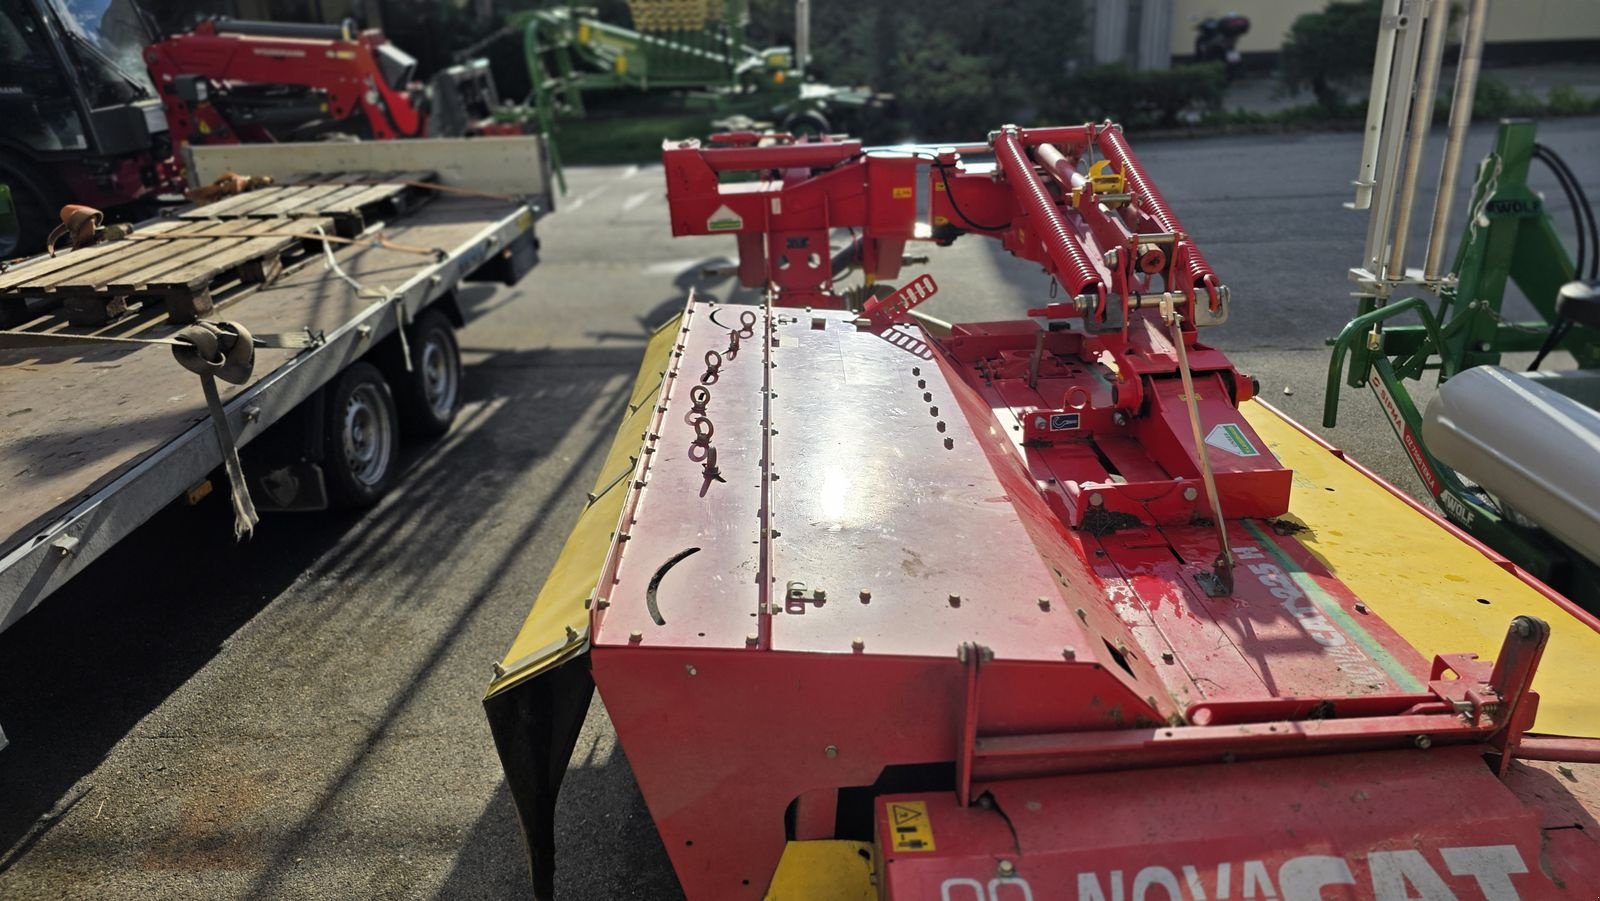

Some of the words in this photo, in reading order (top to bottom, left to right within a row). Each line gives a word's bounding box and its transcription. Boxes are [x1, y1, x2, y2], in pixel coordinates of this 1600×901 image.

[1380, 390, 1402, 428] SIPMA
[1421, 462, 1436, 487] TEKLA
[1446, 495, 1475, 524] WOLF
[1232, 547, 1265, 560] H
